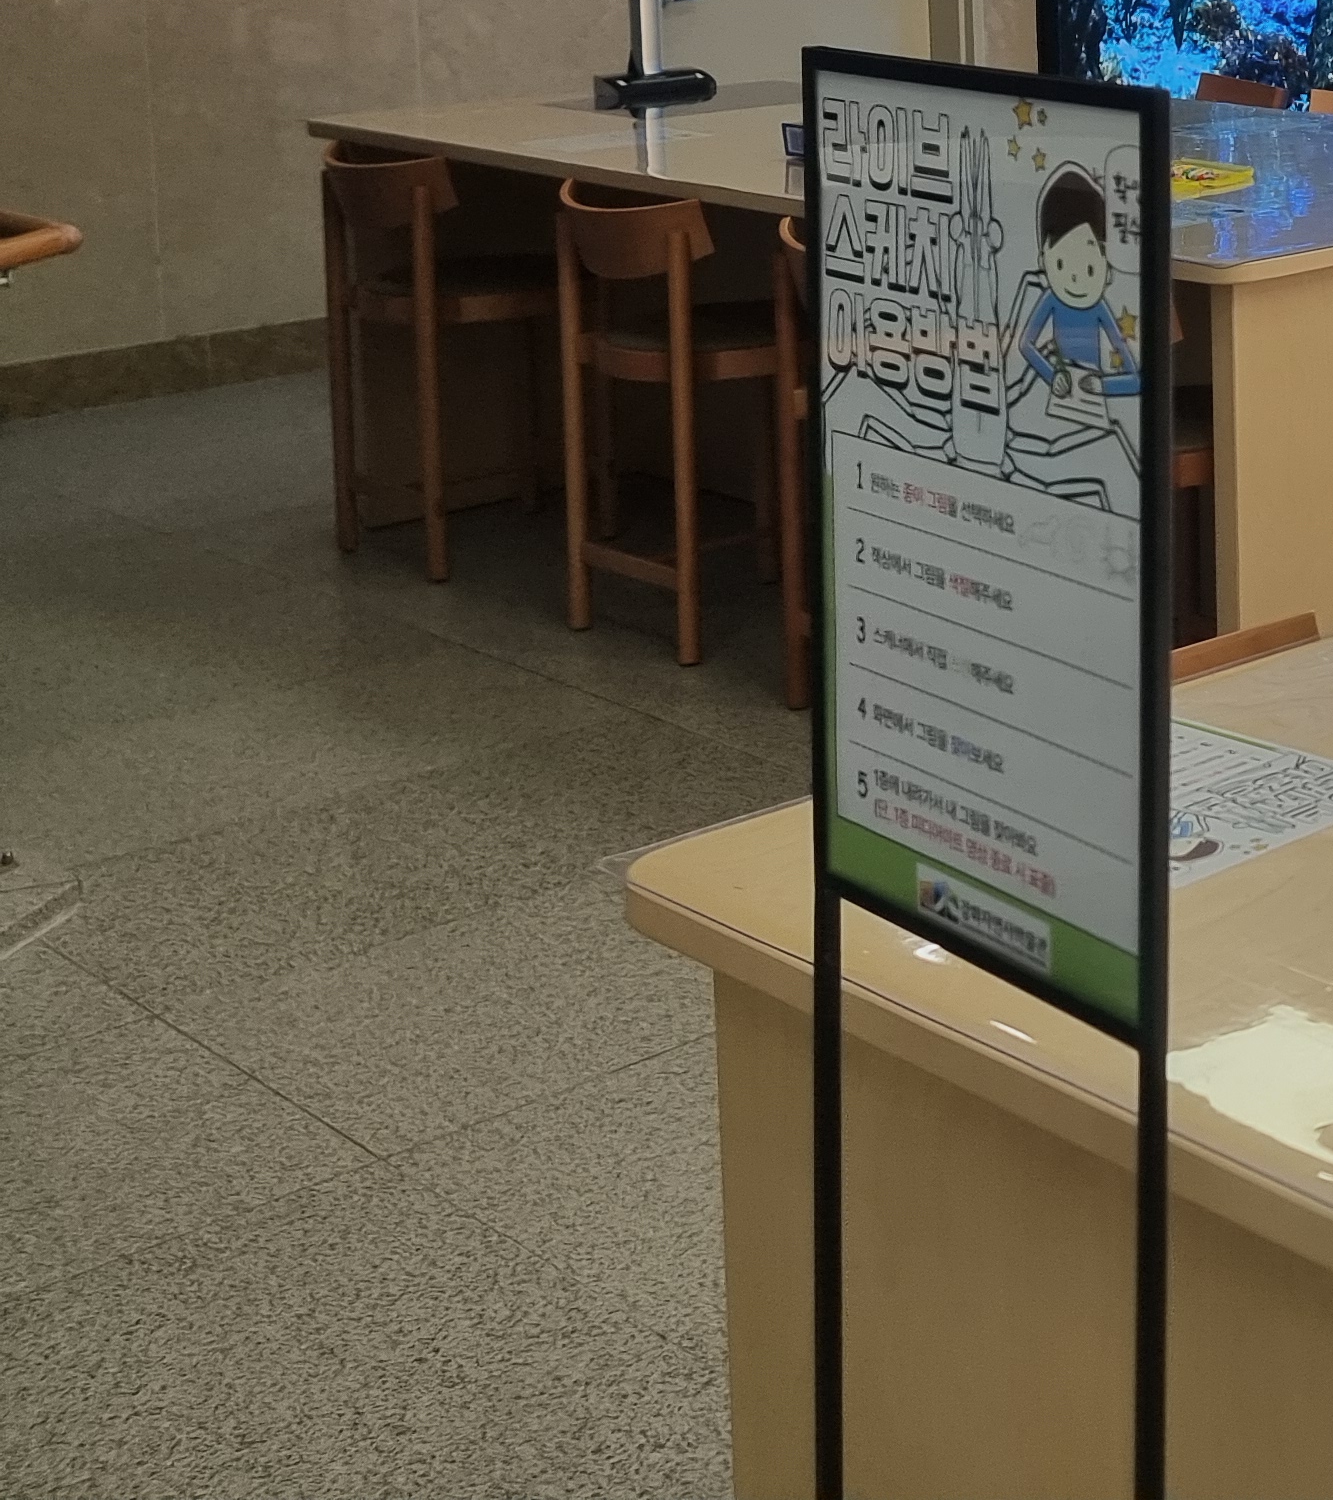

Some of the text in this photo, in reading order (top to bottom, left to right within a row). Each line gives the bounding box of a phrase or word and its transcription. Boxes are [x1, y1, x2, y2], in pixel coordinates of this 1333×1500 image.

[822, 96, 953, 204] 라이브
[825, 194, 951, 303] 스케치
[828, 287, 1000, 416] 이용방법
[856, 461, 864, 489] 1
[856, 537, 865, 564] 2
[856, 616, 866, 644] 3
[857, 697, 867, 720] 4
[857, 770, 868, 798] 5
